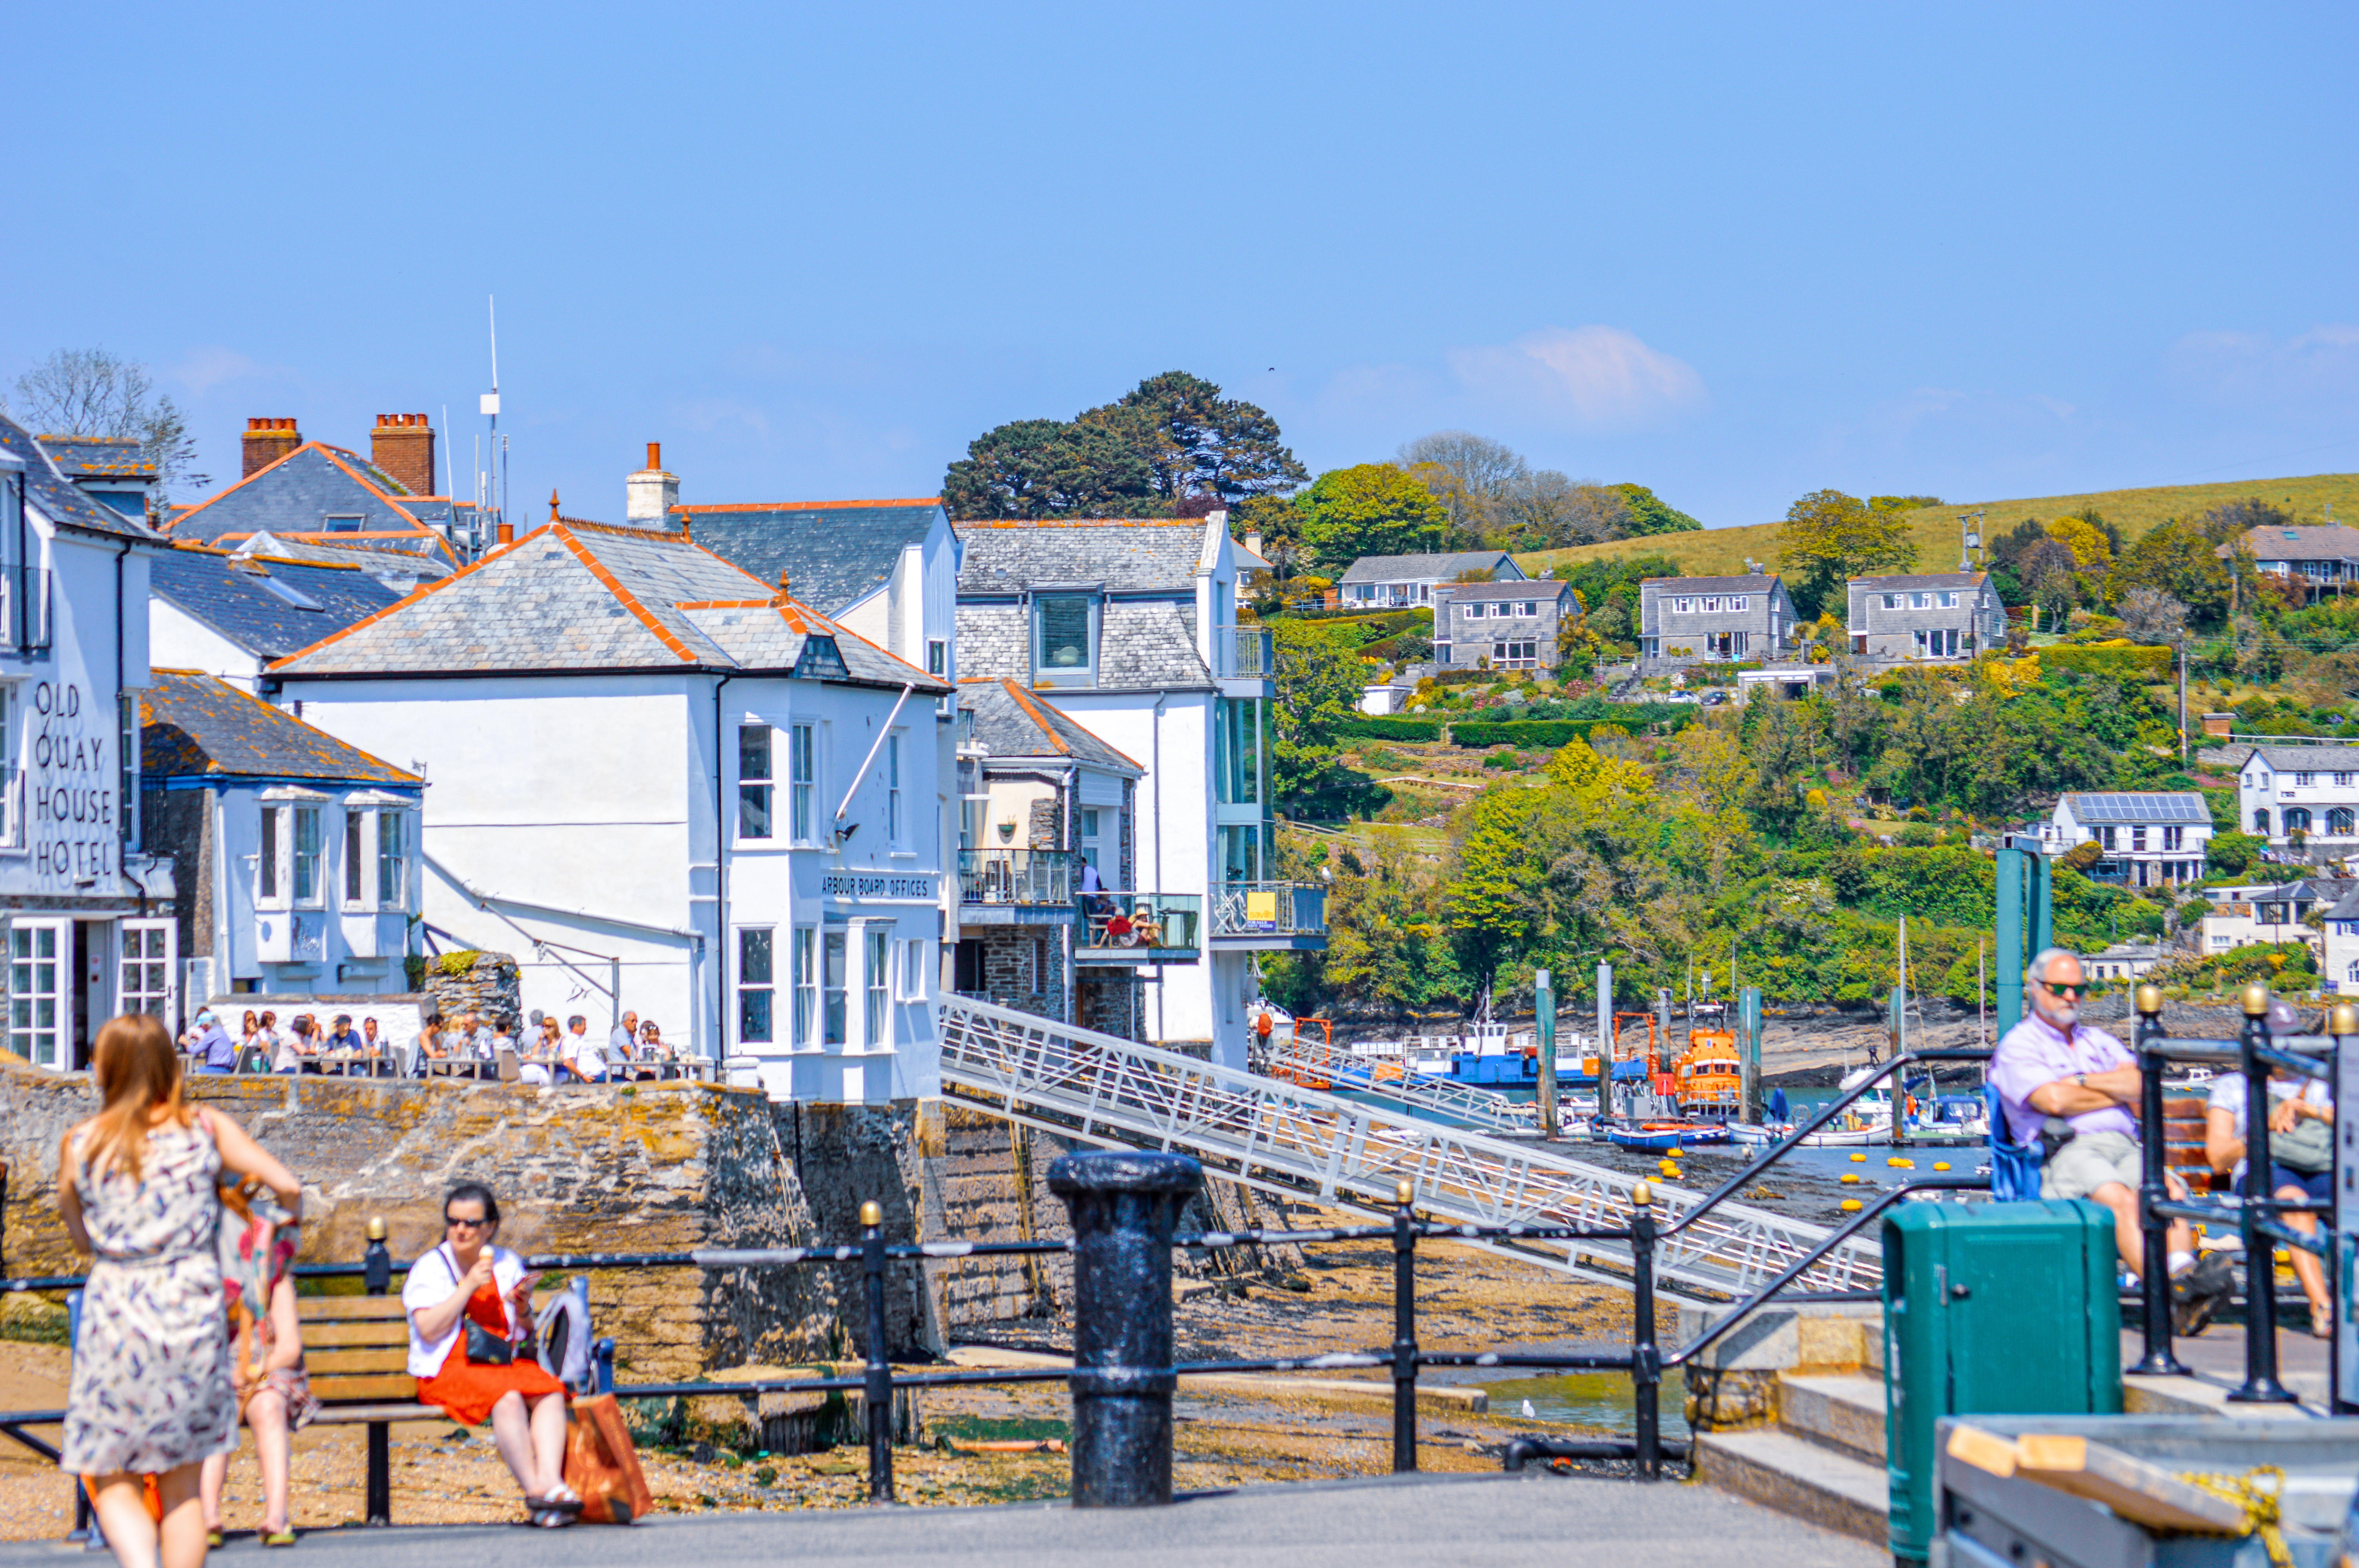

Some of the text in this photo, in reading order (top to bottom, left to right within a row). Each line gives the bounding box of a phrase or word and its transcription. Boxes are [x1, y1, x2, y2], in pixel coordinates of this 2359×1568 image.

[36, 681, 79, 718] OLD
[36, 717, 102, 771] QUAY
[37, 787, 110, 824] HOUSE
[38, 841, 110, 875] HOTEL
[822, 876, 927, 896] ARBOUR BOARD OFFICES
[1249, 910, 1273, 918] savills
